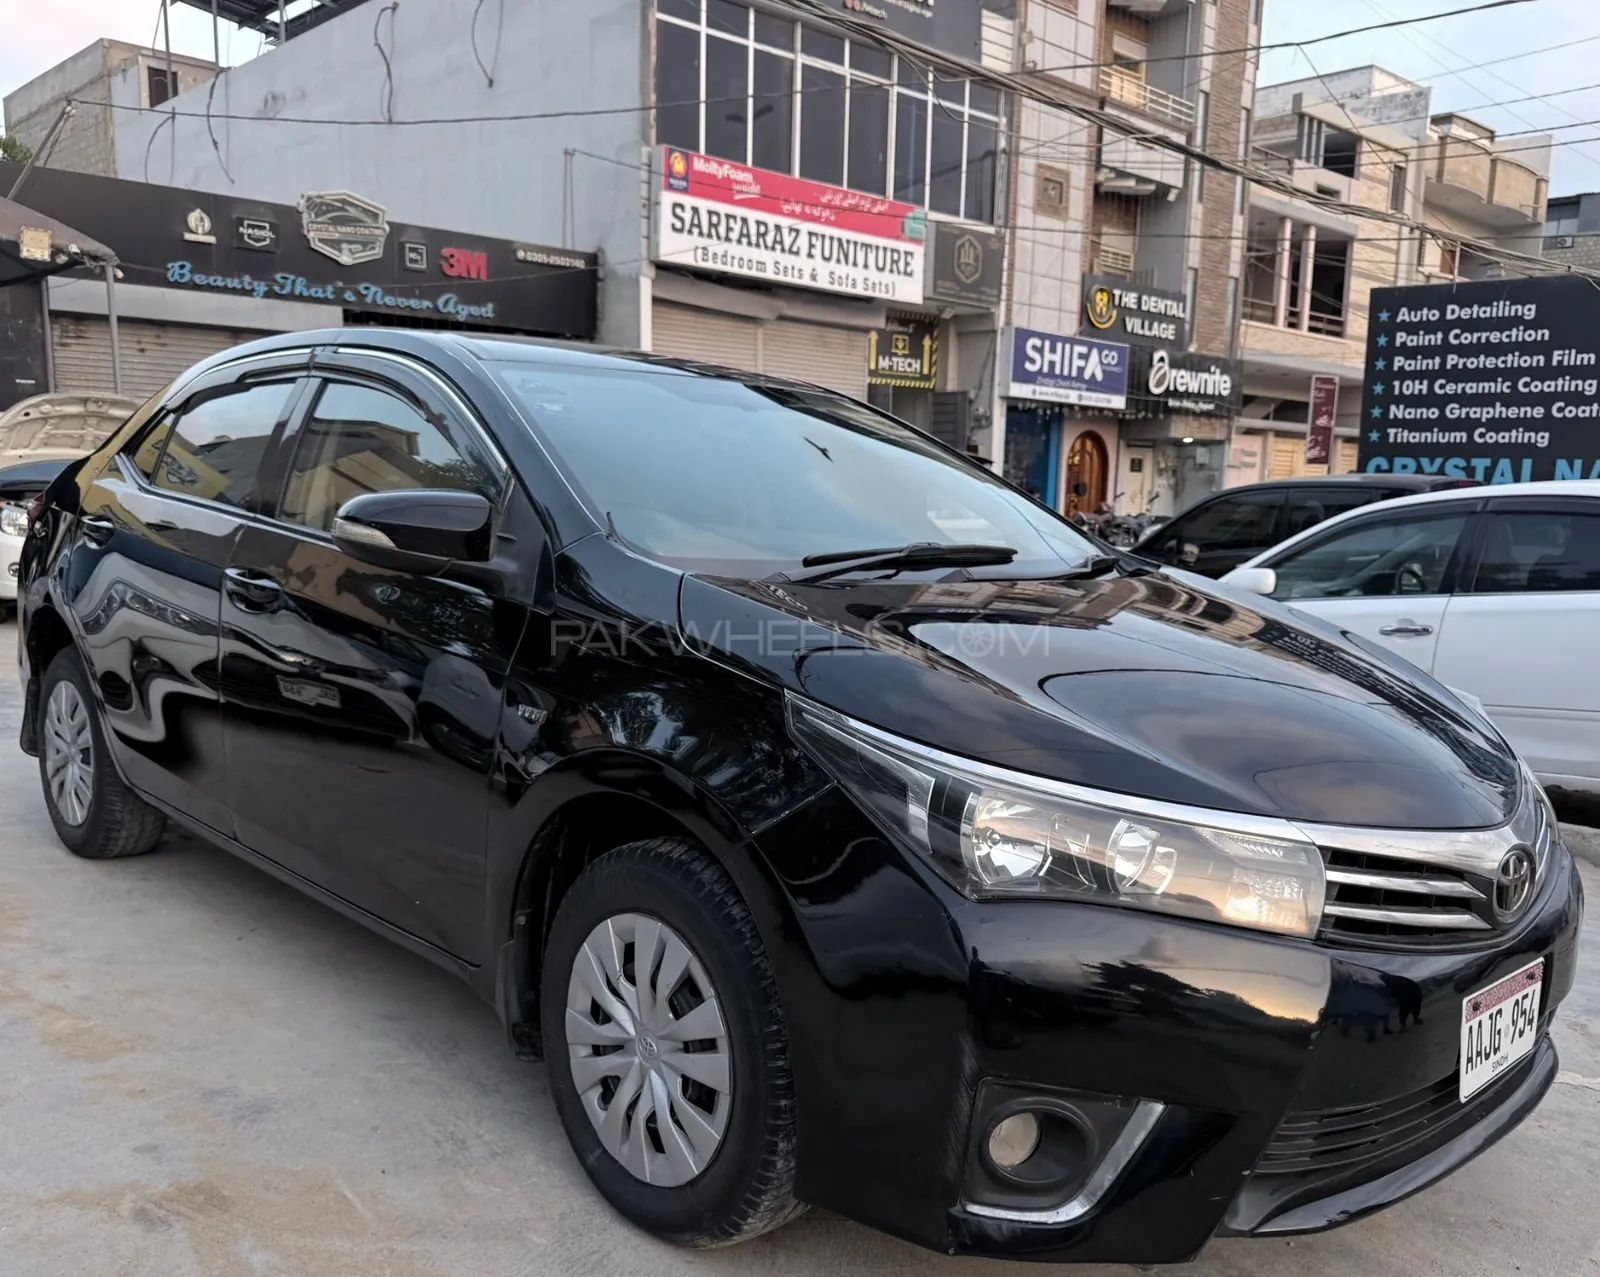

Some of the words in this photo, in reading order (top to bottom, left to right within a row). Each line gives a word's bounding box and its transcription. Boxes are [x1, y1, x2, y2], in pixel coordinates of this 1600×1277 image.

[671, 201, 801, 256] SARFARAZ
[806, 231, 914, 278] FUNITURE
[441, 247, 488, 280] 3M
[693, 245, 767, 273] (Bedroom
[773, 261, 804, 280] Sets
[809, 268, 818, 282] &
[828, 271, 858, 290] Sofa
[862, 278, 896, 297] Sets)
[166, 261, 269, 298] Beauty
[357, 283, 434, 310] Never
[437, 293, 495, 322] Aged
[1112, 288, 1138, 310] THE
[1141, 294, 1185, 318] DENTAL
[1396, 307, 1440, 323] Auto
[1445, 301, 1537, 320] Detailing
[1124, 316, 1177, 340] VILLAGE
[1395, 330, 1443, 348] Paint
[1448, 325, 1550, 345] Correction
[877, 354, 921, 373] M-TECH
[1024, 337, 1103, 382] SHIFA
[1393, 355, 1441, 371] Paint
[1446, 351, 1544, 369] Protection
[1551, 349, 1596, 367] Film
[1148, 349, 1232, 397] Brewnite
[1392, 379, 1428, 396] 10H
[1433, 377, 1511, 395] Ceramic
[1517, 376, 1598, 395] Coating
[1388, 404, 1439, 420] Nano
[1445, 402, 1545, 422] Graphene
[1551, 401, 1600, 418] Coat
[1387, 428, 1467, 443] Titanium
[1473, 428, 1550, 447] Coating
[1465, 1008, 1502, 1075] AAJG
[1511, 989, 1536, 1044] 954
[1491, 1052, 1509, 1073] SINDH
